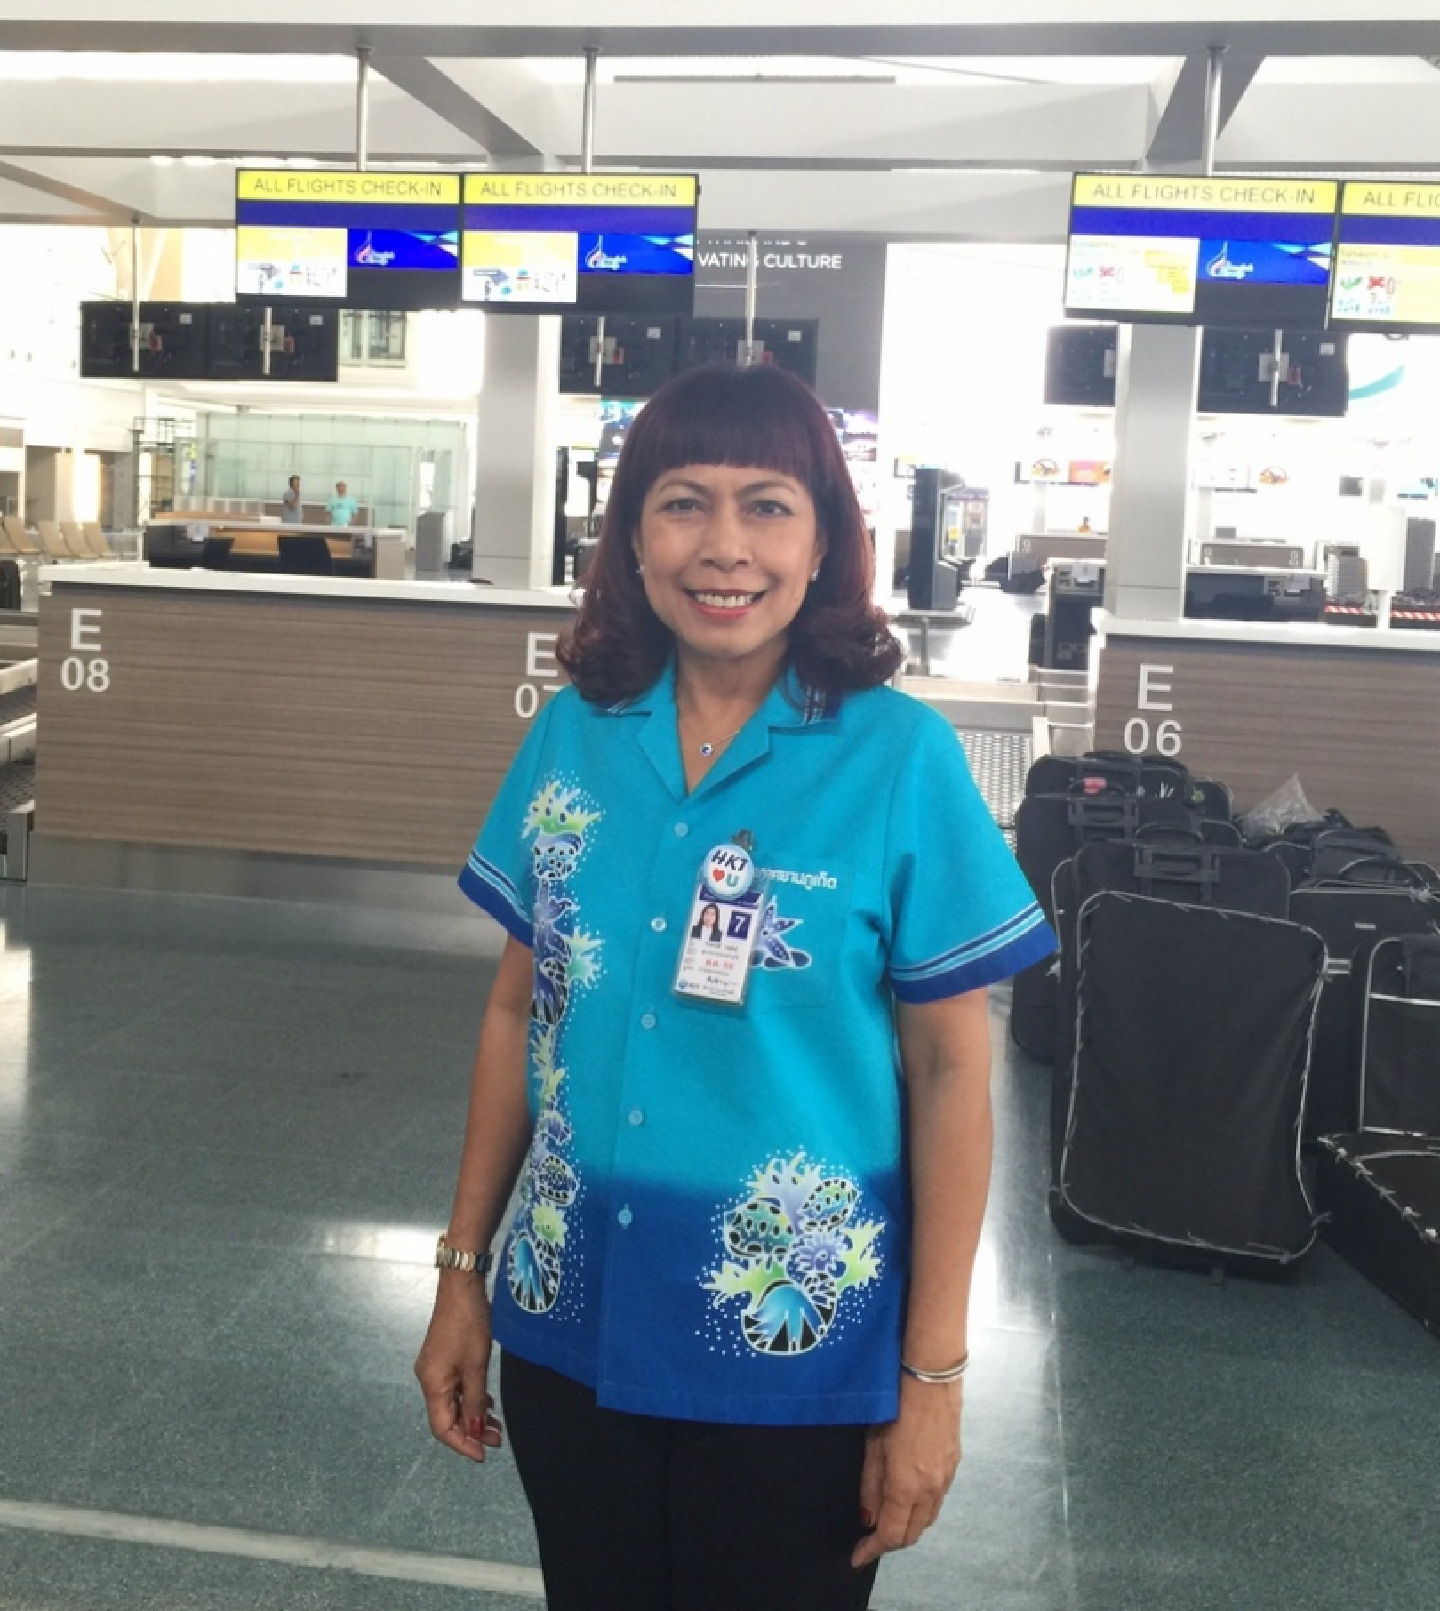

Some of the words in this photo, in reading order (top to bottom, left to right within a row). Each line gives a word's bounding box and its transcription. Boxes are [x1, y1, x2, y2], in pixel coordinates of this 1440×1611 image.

[253, 178, 282, 193] ALL
[287, 178, 357, 194] FLIGHTS
[360, 180, 442, 196] CHECK-IN
[479, 181, 510, 197] ALL
[515, 181, 588, 197] FLIGHTS
[591, 182, 677, 198] CHECK-IN
[1092, 183, 1126, 199] ALL
[1131, 184, 1213, 201] FLIGHTS
[1219, 187, 1315, 204] CHECK-IN
[1362, 190, 1397, 207] ALL
[698, 252, 760, 268] VATIN
[763, 253, 843, 269] CULTURE
[71, 608, 102, 651] E
[526, 631, 559, 677] E
[60, 656, 110, 693] 08
[1138, 663, 1174, 711] E
[1124, 717, 1182, 756] 06
[711, 850, 748, 871] HKT
[726, 874, 739, 887] U
[735, 915, 746, 933] 7
